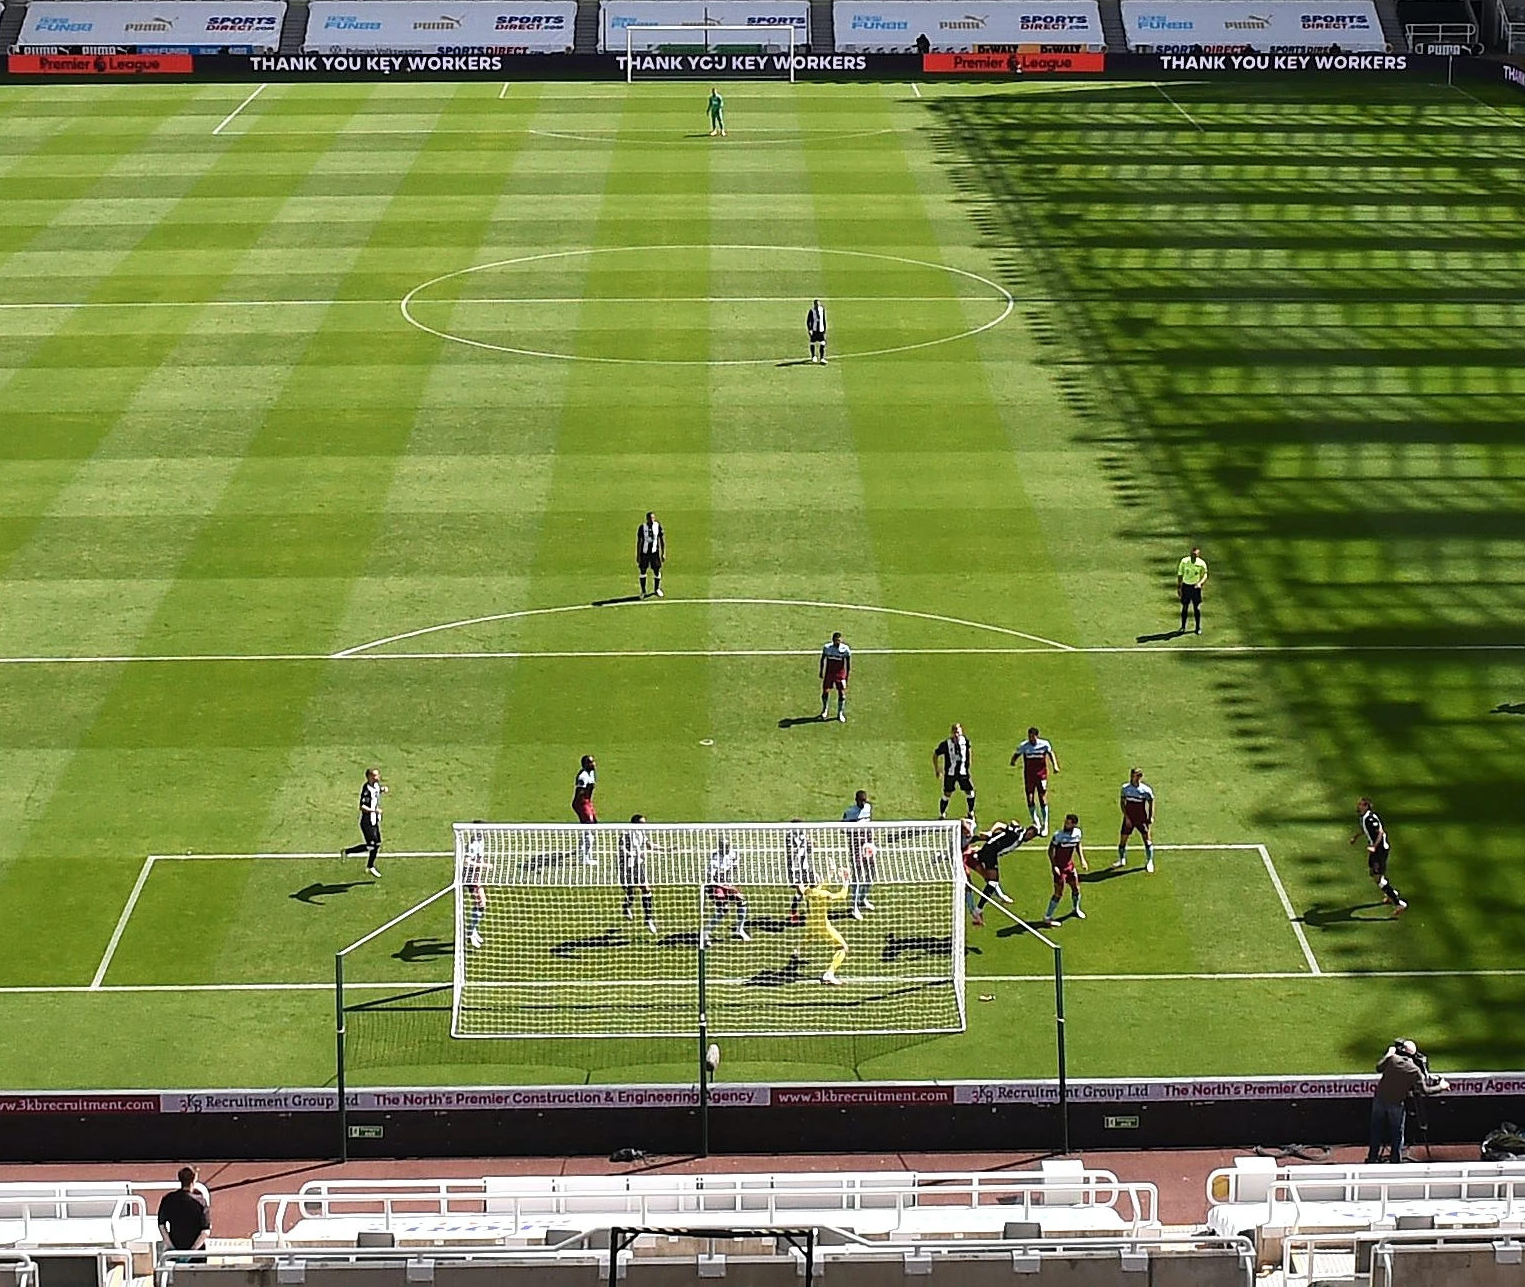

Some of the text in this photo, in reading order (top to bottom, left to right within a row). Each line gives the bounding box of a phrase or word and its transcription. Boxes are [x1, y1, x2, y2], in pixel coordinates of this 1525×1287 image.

[207, 16, 277, 24] SPORTS
[495, 16, 564, 24] SPORTS
[747, 16, 805, 24] SPORTS
[1020, 15, 1088, 23] SPORTS
[1301, 15, 1368, 23] SPORTS
[39, 56, 160, 73] Premier League
[250, 55, 502, 71] THANK YOU KEY WORKERS
[616, 55, 866, 71] THANK YOU KEY WORKERS
[954, 55, 1072, 72] Premier League
[1160, 54, 1406, 71] THANK YOU KEY WORKERS
[206, 1089, 754, 1111] Recruitment Group The North's Premier Construction & Engineering Agency
[779, 1088, 948, 1103] www.3kbrecruitment.com
[998, 1081, 1380, 1103] Recruitmnt Group Ltd The North's Premier Constructio
